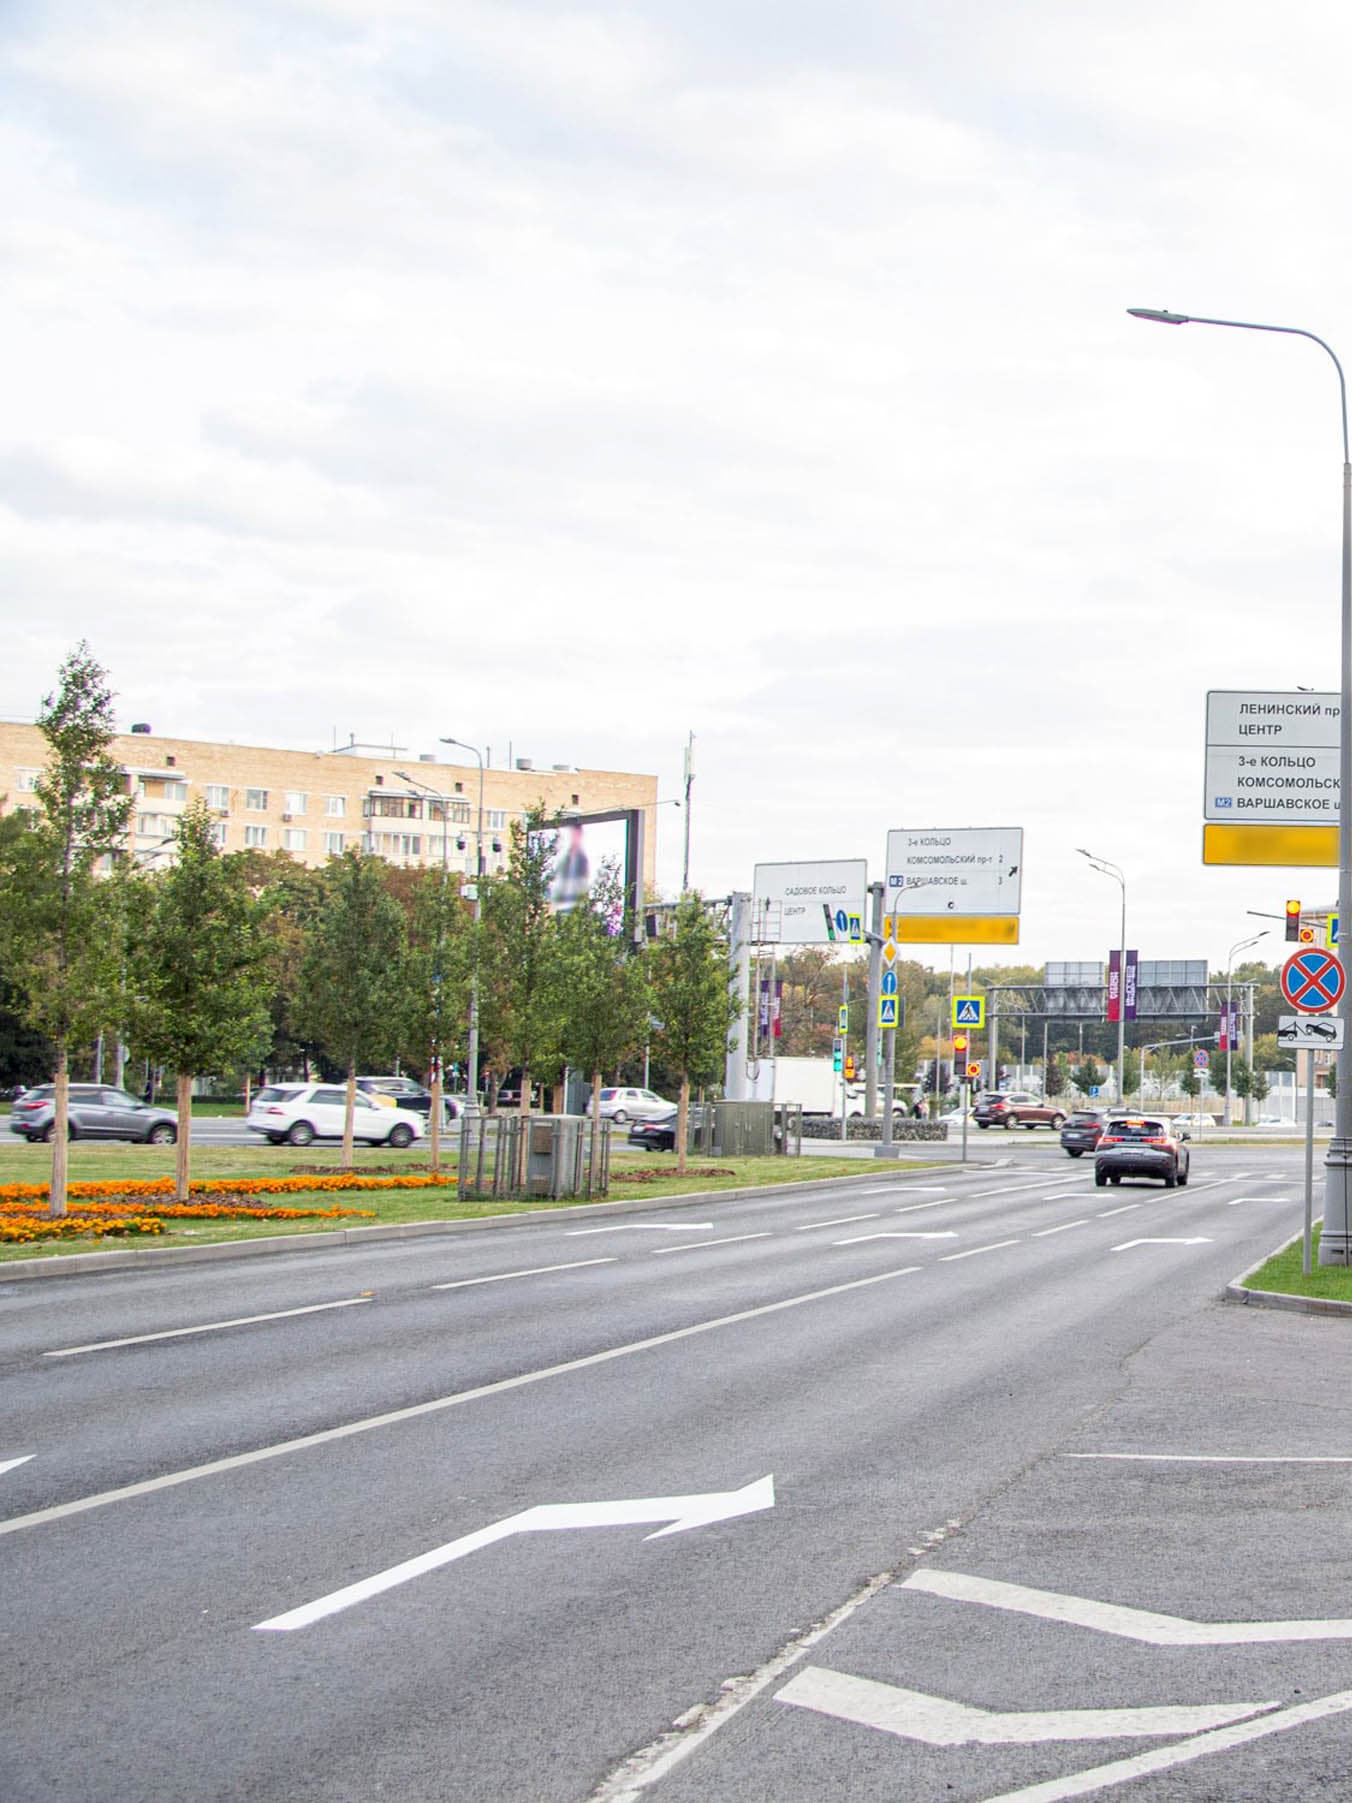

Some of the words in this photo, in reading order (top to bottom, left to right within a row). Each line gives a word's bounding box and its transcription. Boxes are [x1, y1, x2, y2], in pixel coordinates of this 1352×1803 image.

[1239, 703, 1321, 715] ЛЕНИНСКИЙ
[1324, 707, 1341, 718] пр
[1239, 724, 1283, 737] ЦЕНТР
[1238, 756, 1257, 767] 3-е
[1260, 756, 1317, 769] КОЛЬЦО
[1237, 798, 1331, 810] ВАРШАВСКОЕ
[920, 837, 952, 848] КОЛЬЦО
[906, 855, 976, 865] КОМСОМОЛЬСКИЙ
